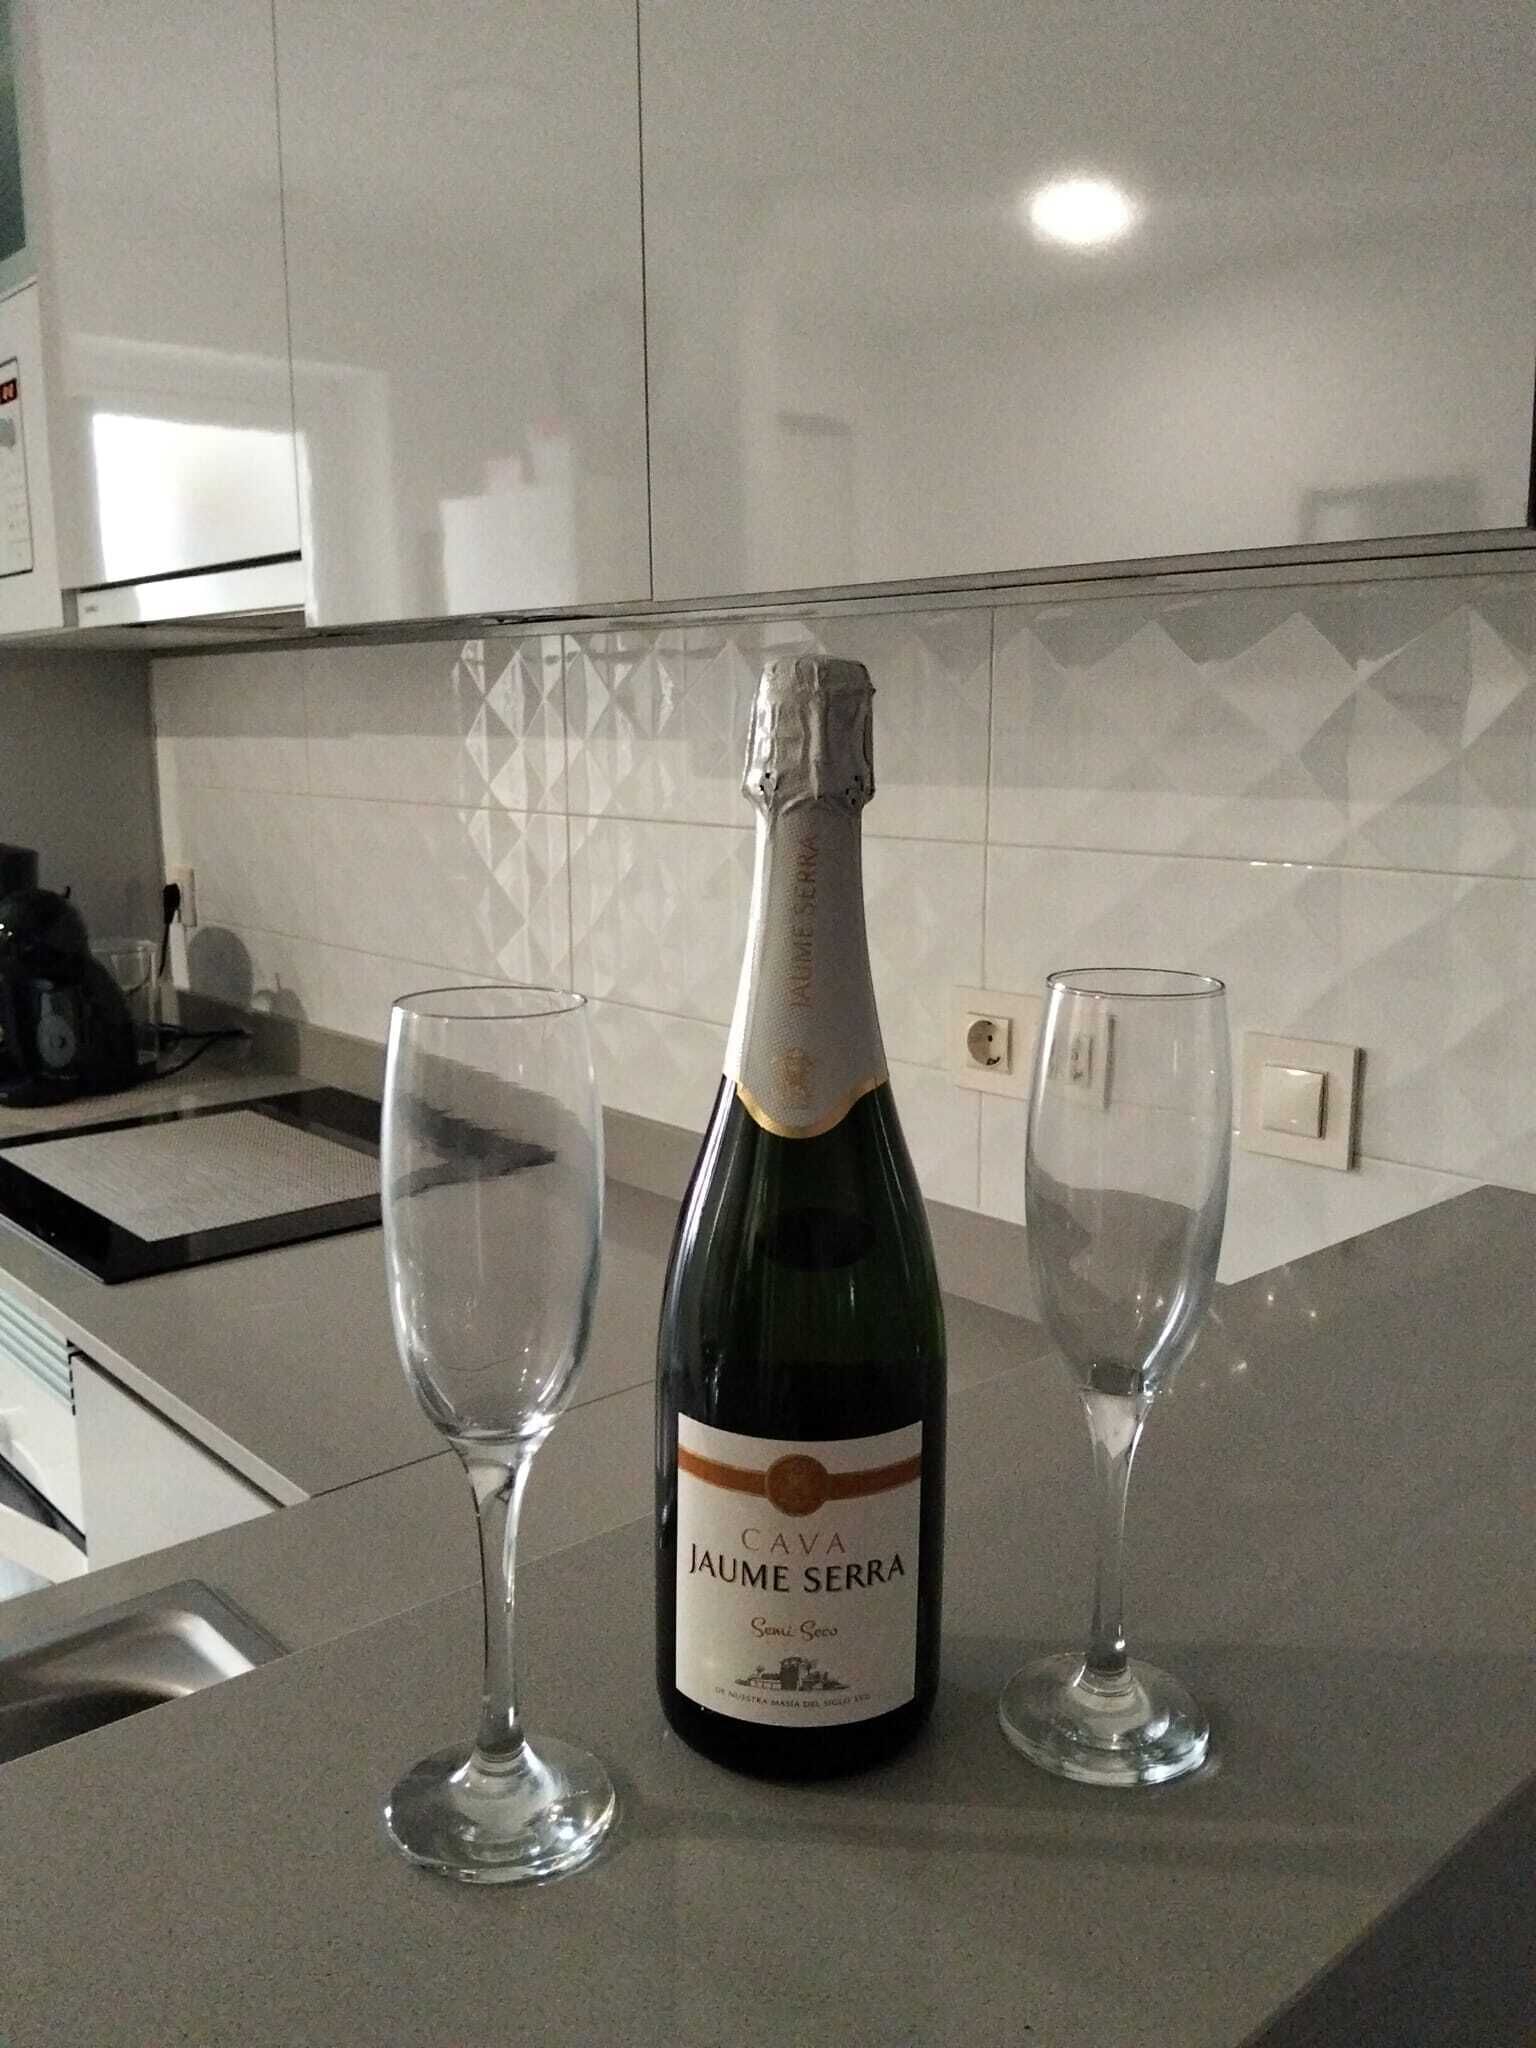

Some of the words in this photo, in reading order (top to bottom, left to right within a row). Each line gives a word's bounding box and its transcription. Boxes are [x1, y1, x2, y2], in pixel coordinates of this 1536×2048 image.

[792, 834, 819, 916] SERRA
[790, 924, 815, 1009] JAUME
[741, 1527, 846, 1555] CAVA
[689, 1543, 790, 1593] JAUME
[803, 1553, 905, 1594] SERRA
[751, 1615, 796, 1638] Semi
[800, 1619, 838, 1642] Seco
